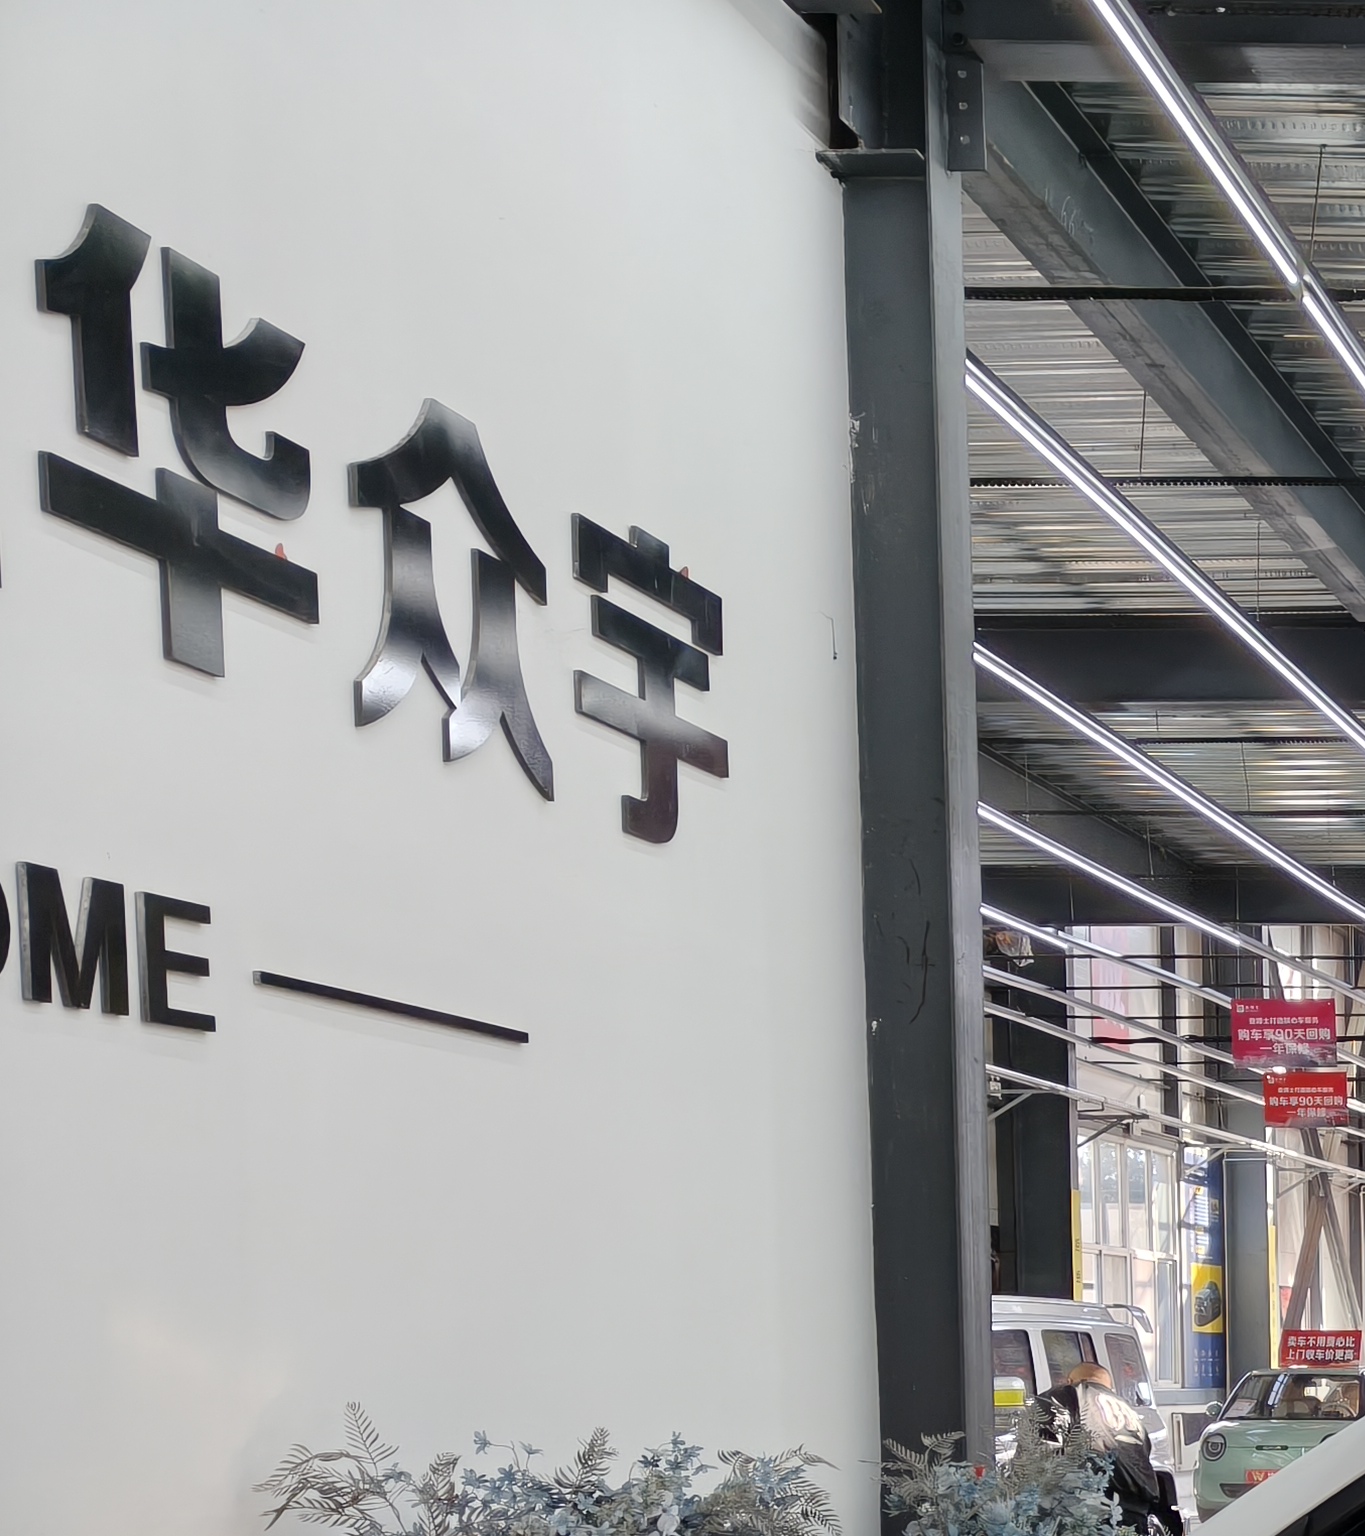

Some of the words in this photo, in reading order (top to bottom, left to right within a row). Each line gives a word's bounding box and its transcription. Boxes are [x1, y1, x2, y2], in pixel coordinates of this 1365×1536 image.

[35, 204, 729, 843] 华众宇
[0, 861, 216, 1033] ME
[1238, 1028, 1331, 1041] 购车享90天回购
[1260, 1042, 1310, 1055] 一年保修
[1269, 1096, 1343, 1106] 购车享90天回购
[1286, 1348, 1355, 1361] 上门收车价更高
